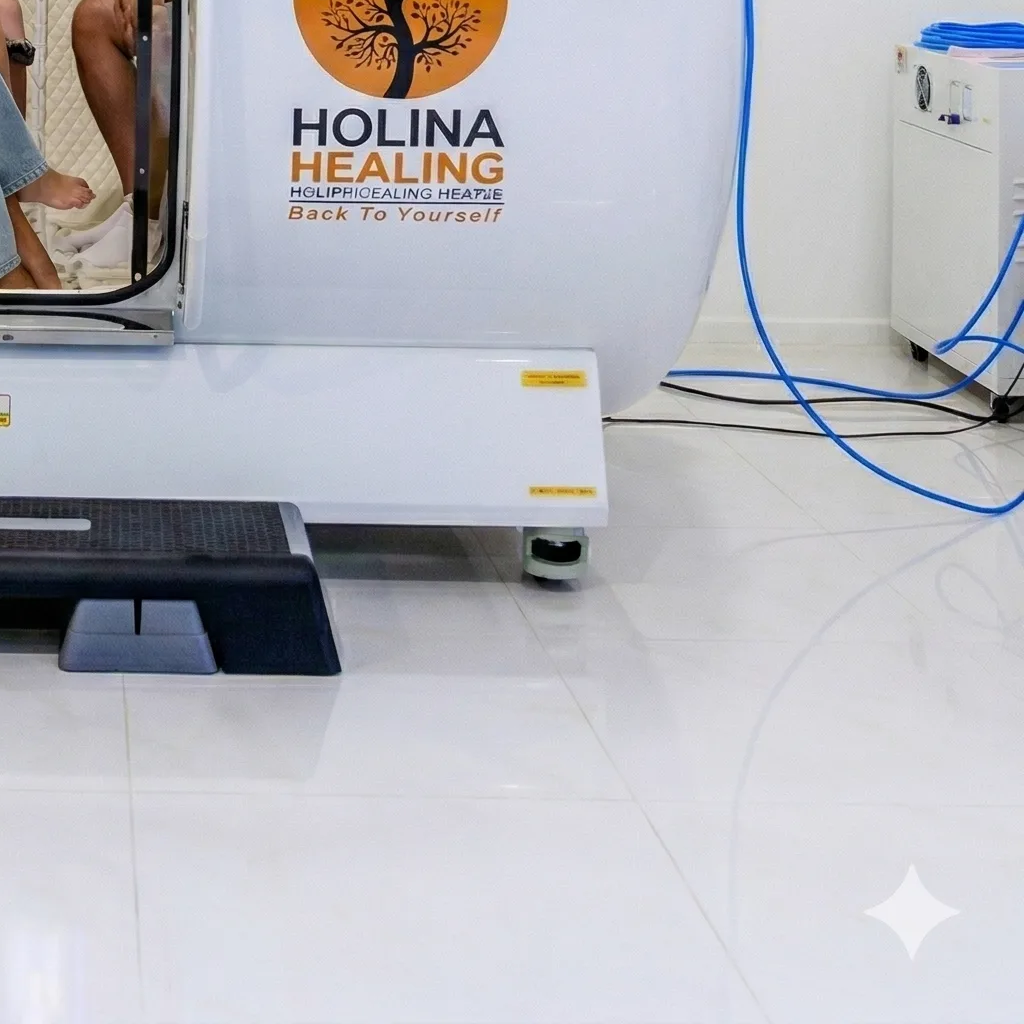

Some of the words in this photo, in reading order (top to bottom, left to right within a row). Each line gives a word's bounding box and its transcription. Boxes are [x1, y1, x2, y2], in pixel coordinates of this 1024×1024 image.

[292, 108, 505, 147] HOLINA
[291, 151, 504, 184] HEALING
[288, 205, 349, 221] Back
[360, 206, 387, 221] To
[398, 207, 503, 223] Yourself
